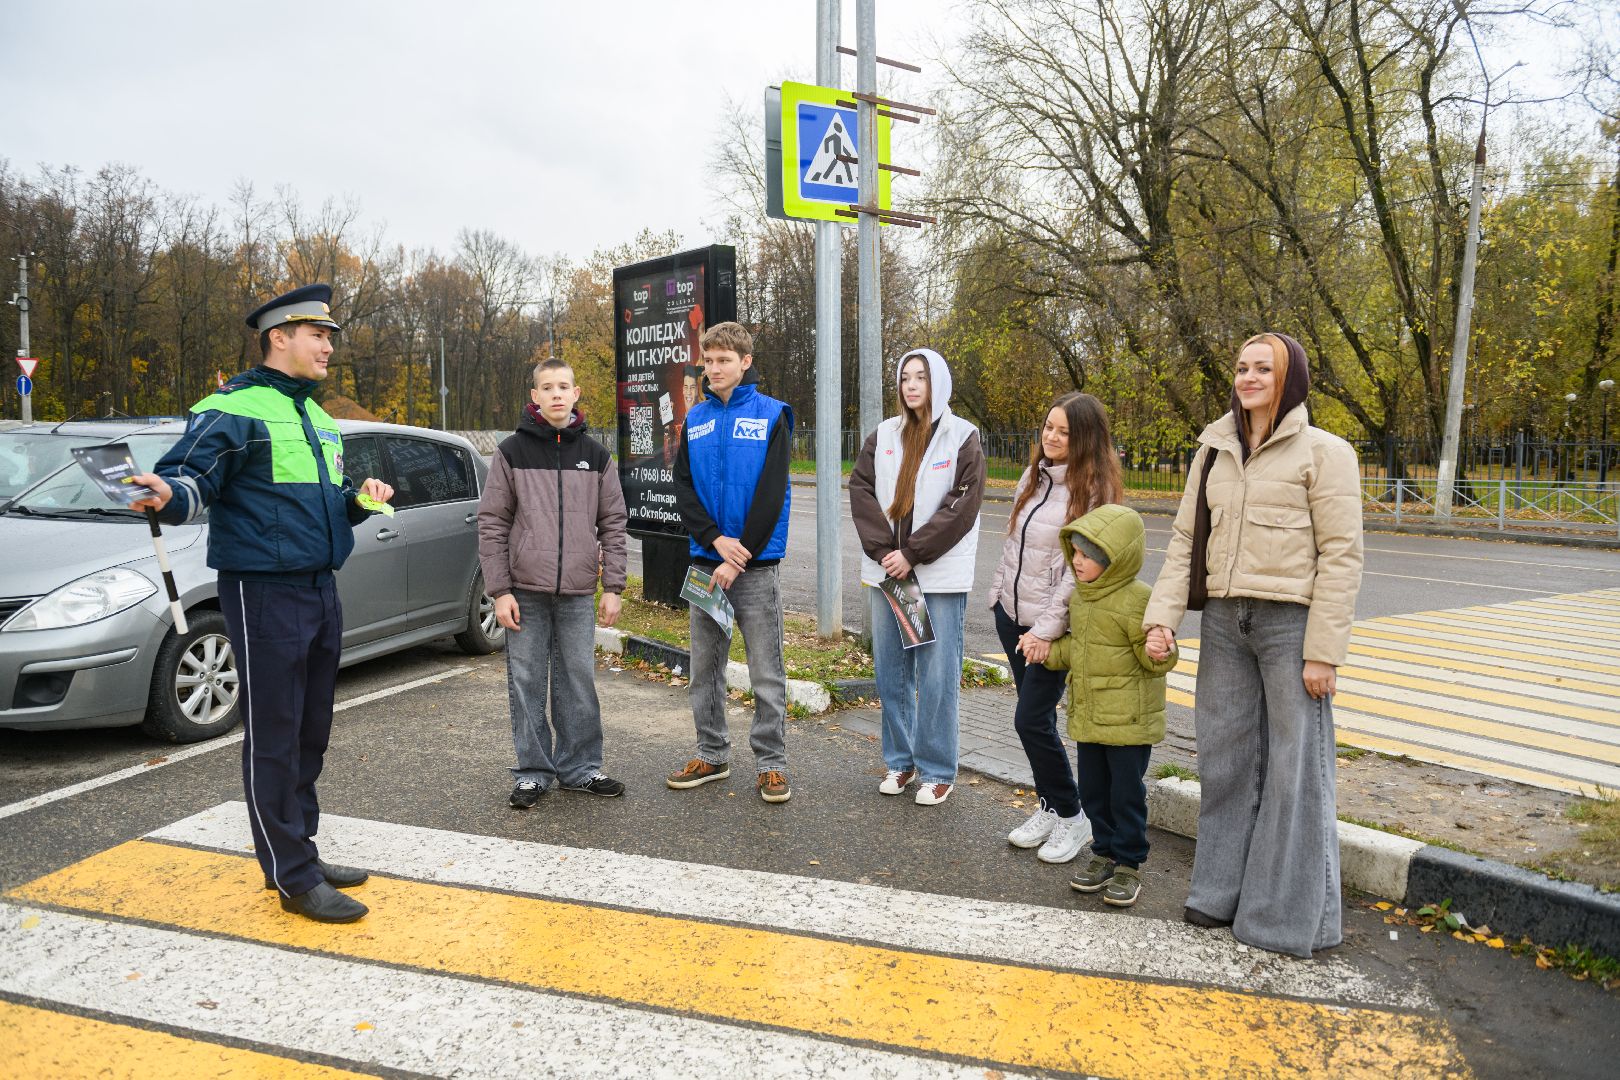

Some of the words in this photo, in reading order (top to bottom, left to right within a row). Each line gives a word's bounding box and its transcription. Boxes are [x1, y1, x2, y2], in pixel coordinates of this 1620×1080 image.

[677, 281, 694, 295] top
[633, 290, 648, 303] top
[626, 321, 686, 345] КОЛЛЕДЖ
[627, 351, 635, 367] И
[637, 345, 691, 367] IT-КУРСЫ
[638, 371, 655, 383] ДЕТЕЙ
[630, 467, 639, 480] +7
[640, 467, 659, 484] (968)
[640, 492, 646, 501] г.
[629, 507, 639, 519] ул.
